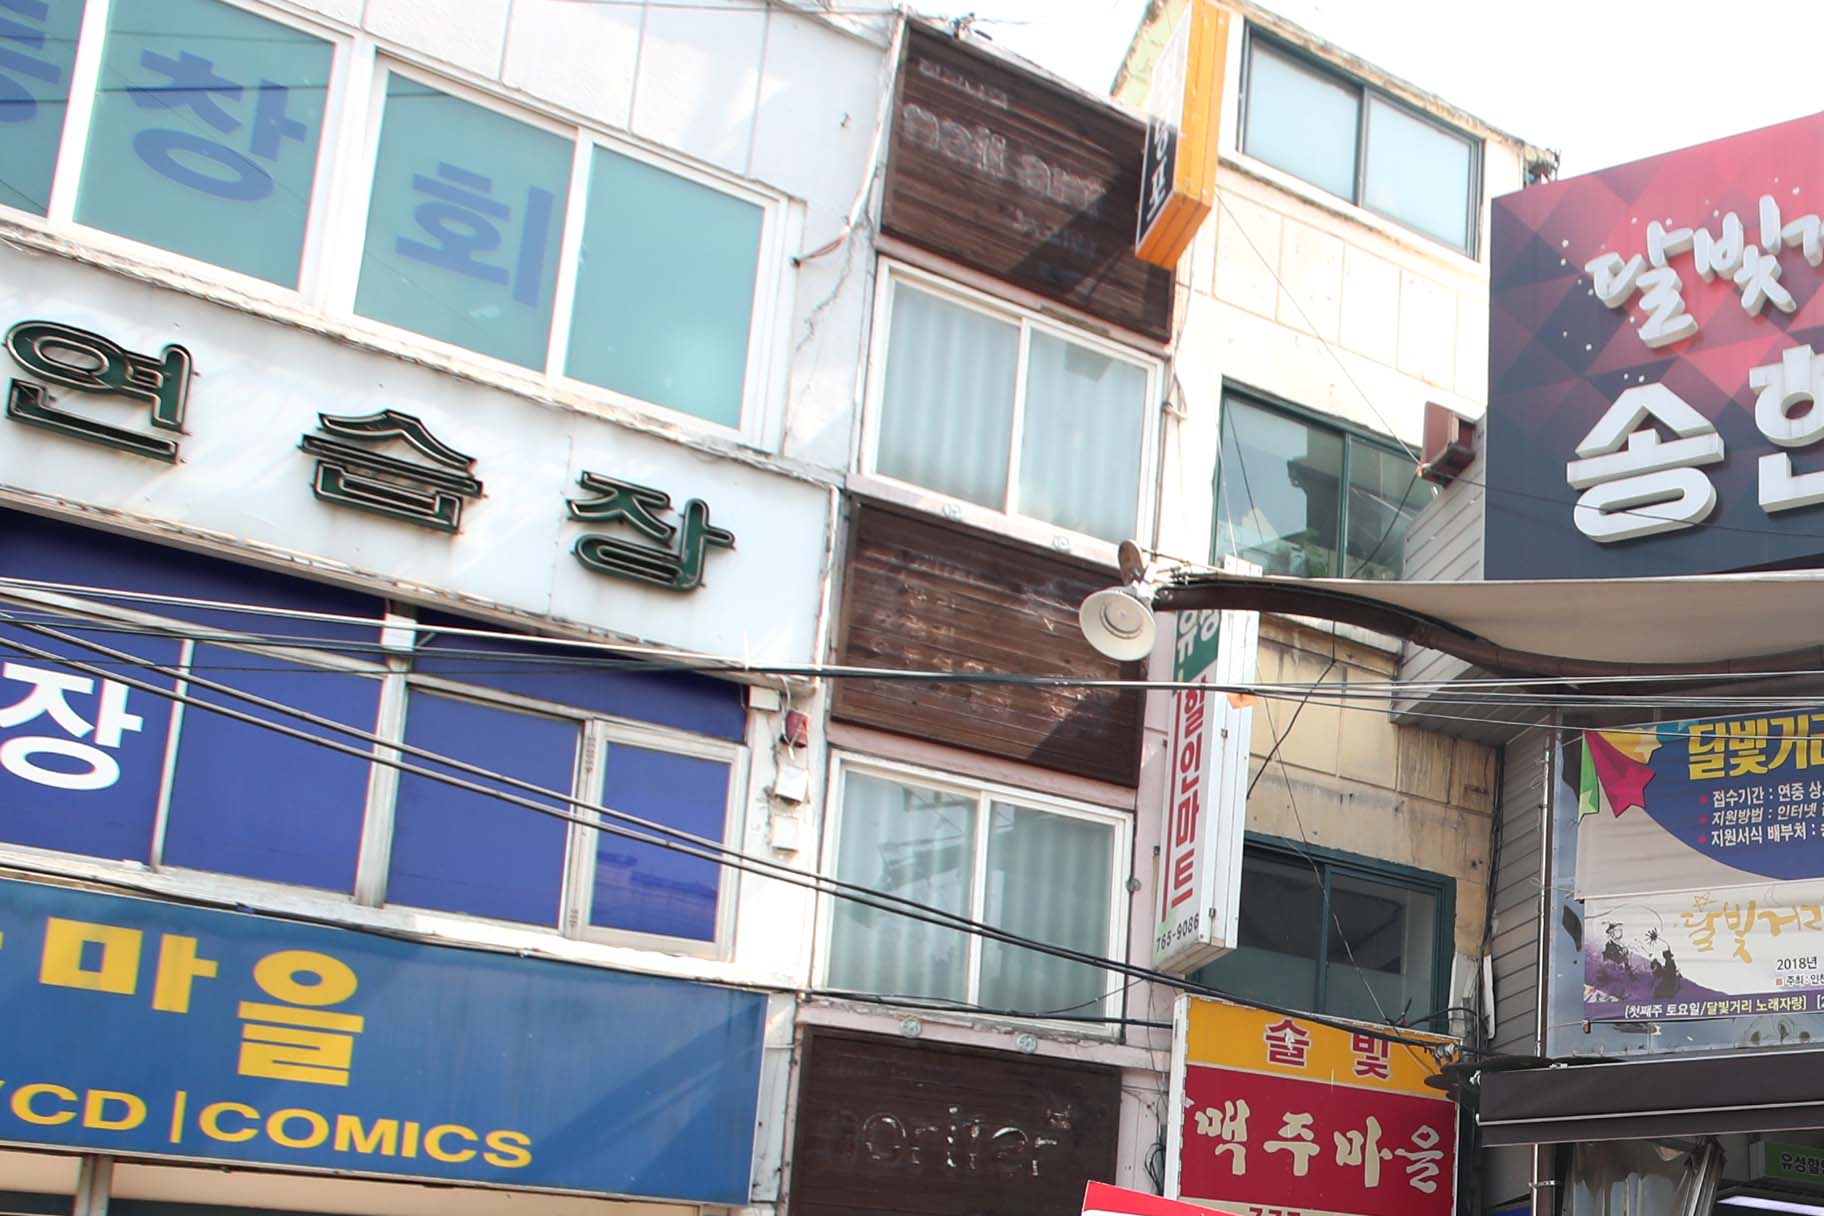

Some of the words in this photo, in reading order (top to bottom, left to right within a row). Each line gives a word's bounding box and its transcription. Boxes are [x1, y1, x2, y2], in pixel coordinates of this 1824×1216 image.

[0, 663, 143, 791] 장
[1712, 786, 1764, 808] 접수기간
[1777, 782, 1804, 802] 연중
[1712, 807, 1764, 826] 지원방법
[1777, 801, 1817, 821] 인터넷
[1711, 825, 1763, 847] 지원서식
[1767, 821, 1807, 843] 배부처
[1776, 956, 1817, 971] 2018년
[0, 1081, 147, 1132] CD
[199, 1101, 535, 1169] COMICS
[1194, 1099, 1444, 1194] 맥주마을
